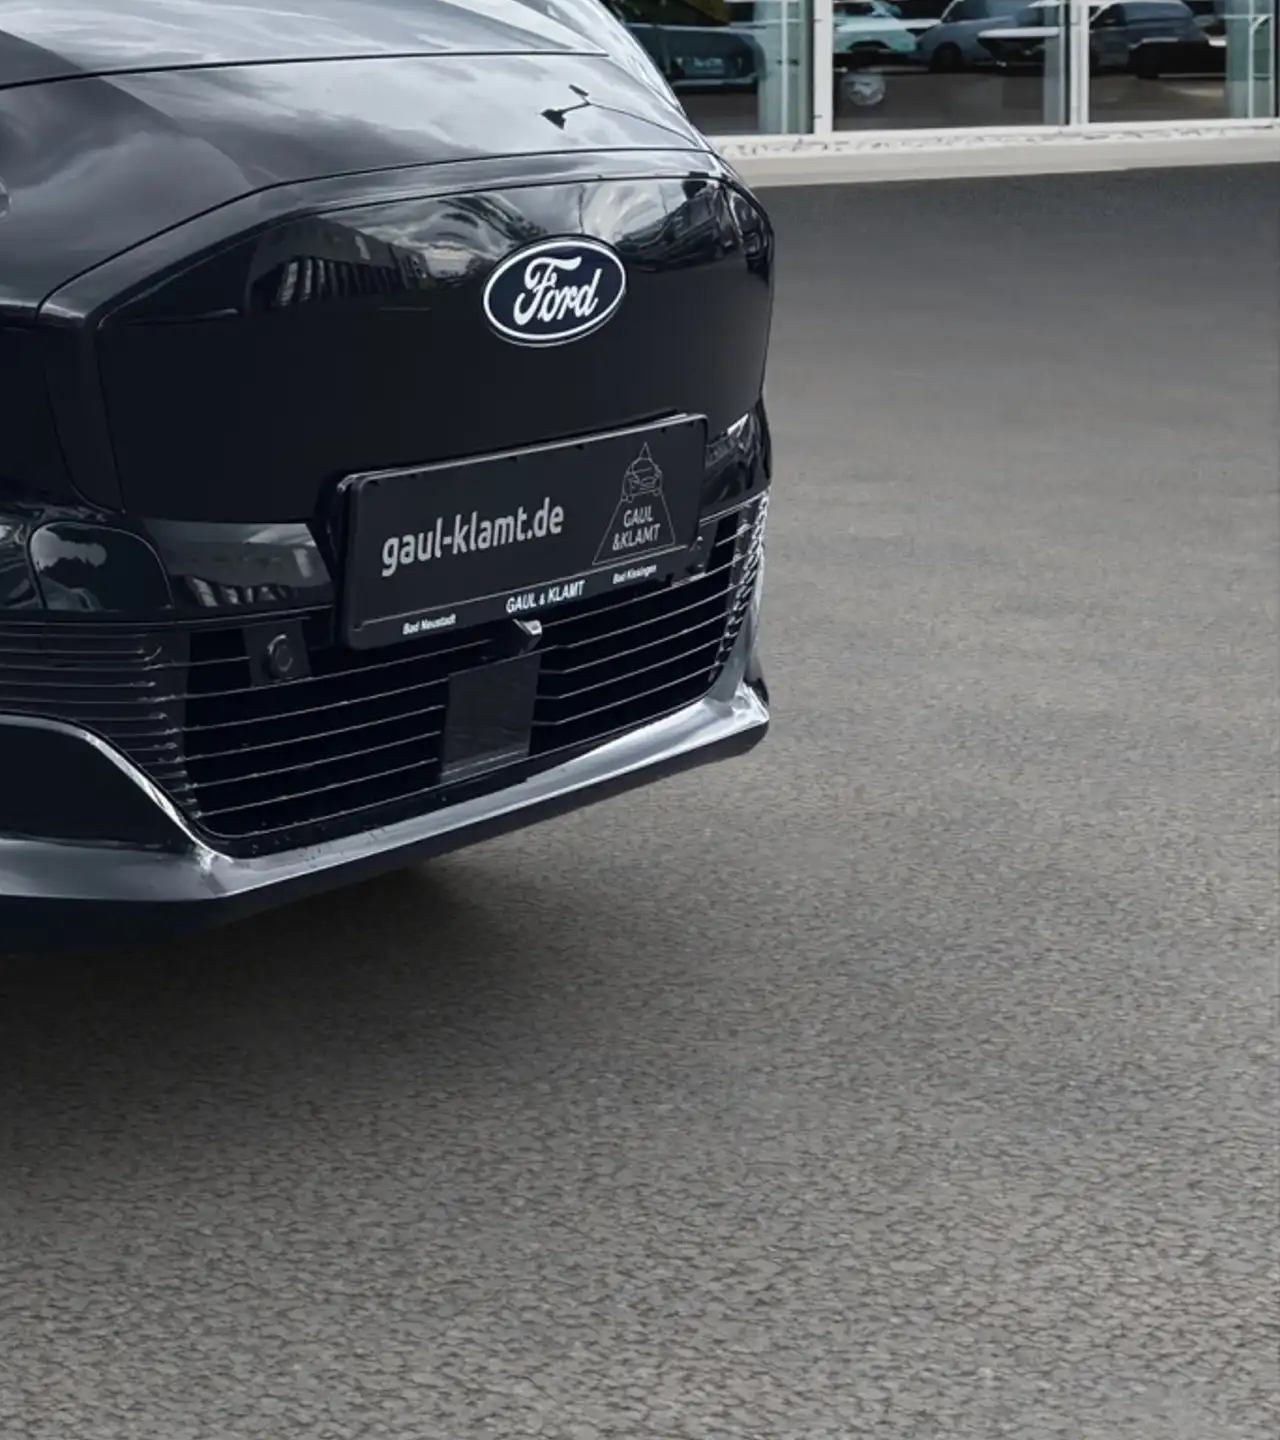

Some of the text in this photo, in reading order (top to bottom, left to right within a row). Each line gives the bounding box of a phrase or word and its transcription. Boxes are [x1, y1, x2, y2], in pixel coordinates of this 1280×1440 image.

[513, 256, 603, 326] Ford
[623, 505, 654, 528] GAUL
[381, 496, 564, 577] gaul-klamt.de
[612, 523, 661, 551] &KLAMT
[612, 571, 627, 585] Bad
[506, 591, 537, 613] GAUL
[547, 580, 585, 603] KLAMT
[402, 613, 457, 635] Bad Neustadt
